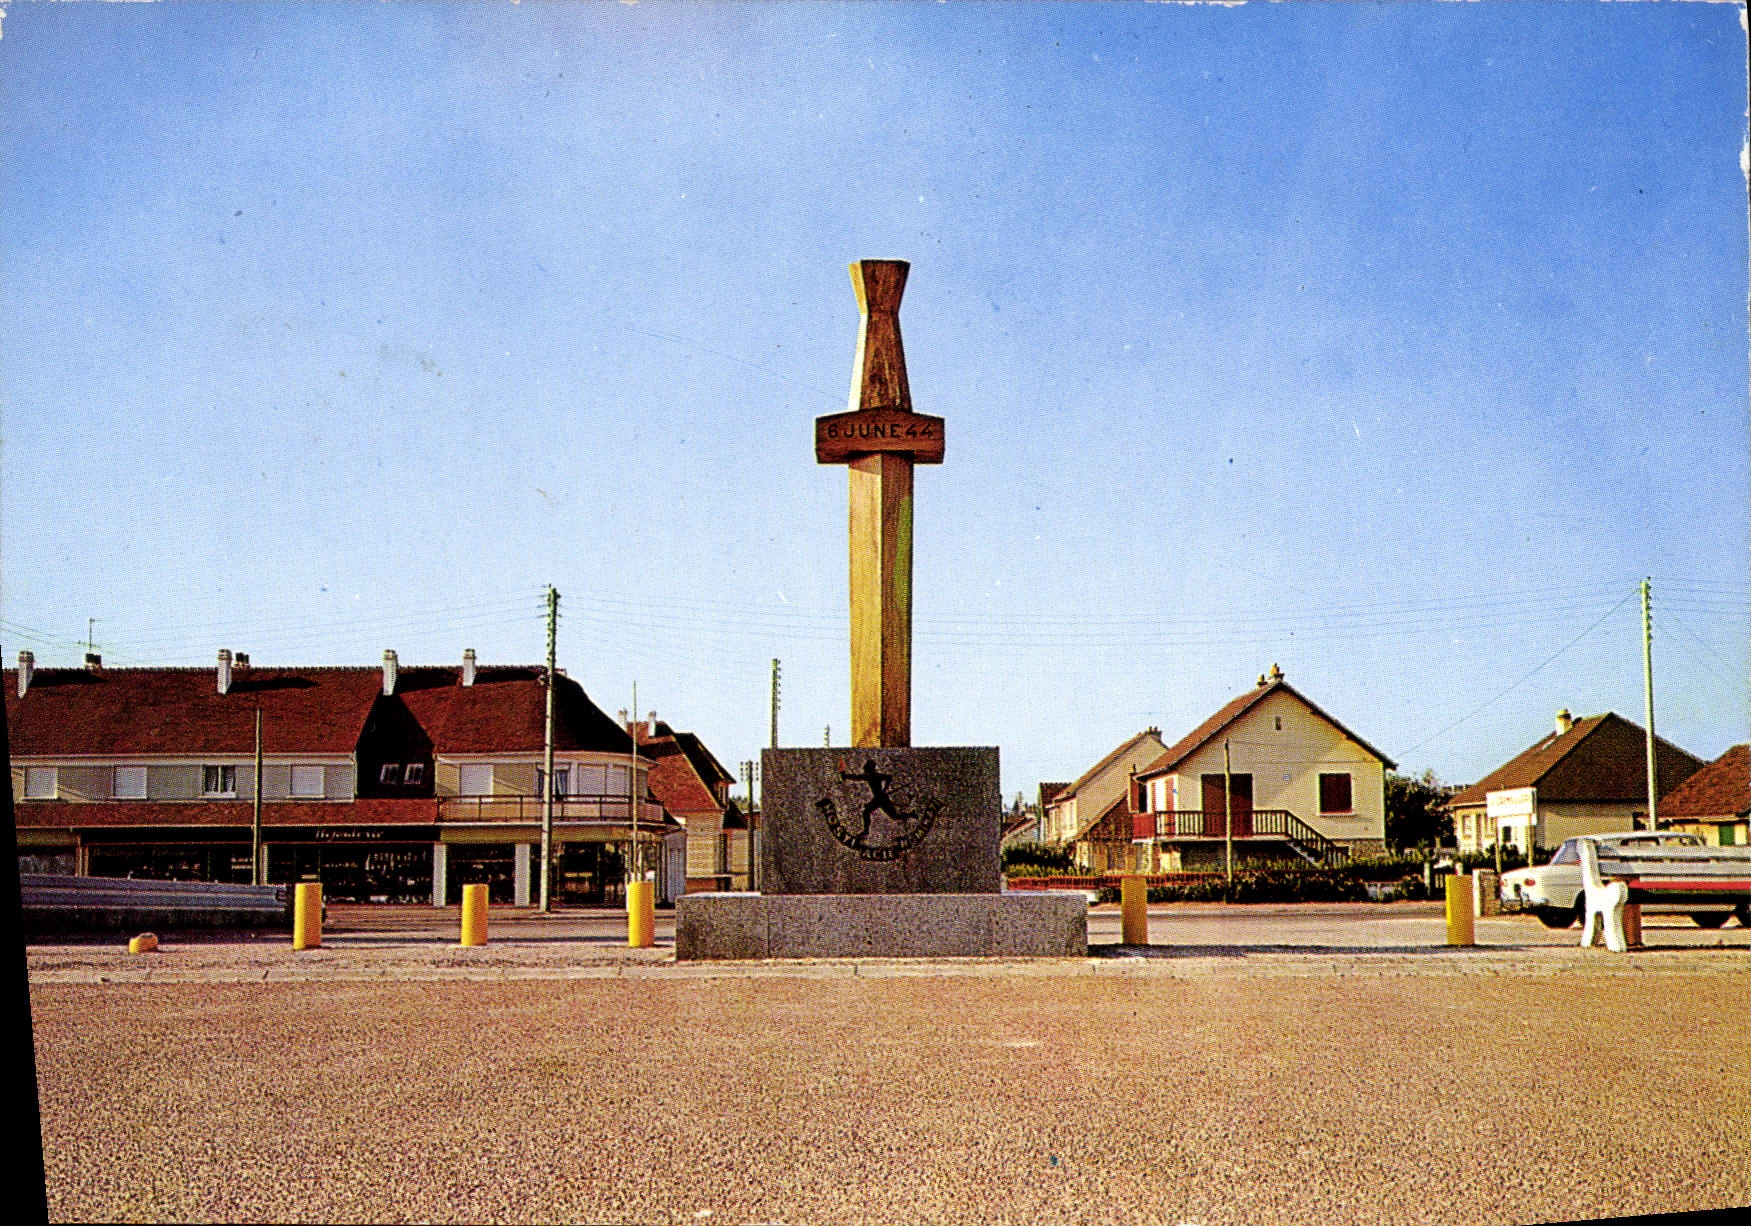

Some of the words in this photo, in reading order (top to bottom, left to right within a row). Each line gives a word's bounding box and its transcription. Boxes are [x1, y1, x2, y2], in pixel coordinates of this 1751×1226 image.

[827, 423, 838, 439] 6
[843, 423, 901, 439] JUNE
[904, 422, 933, 438] 44
